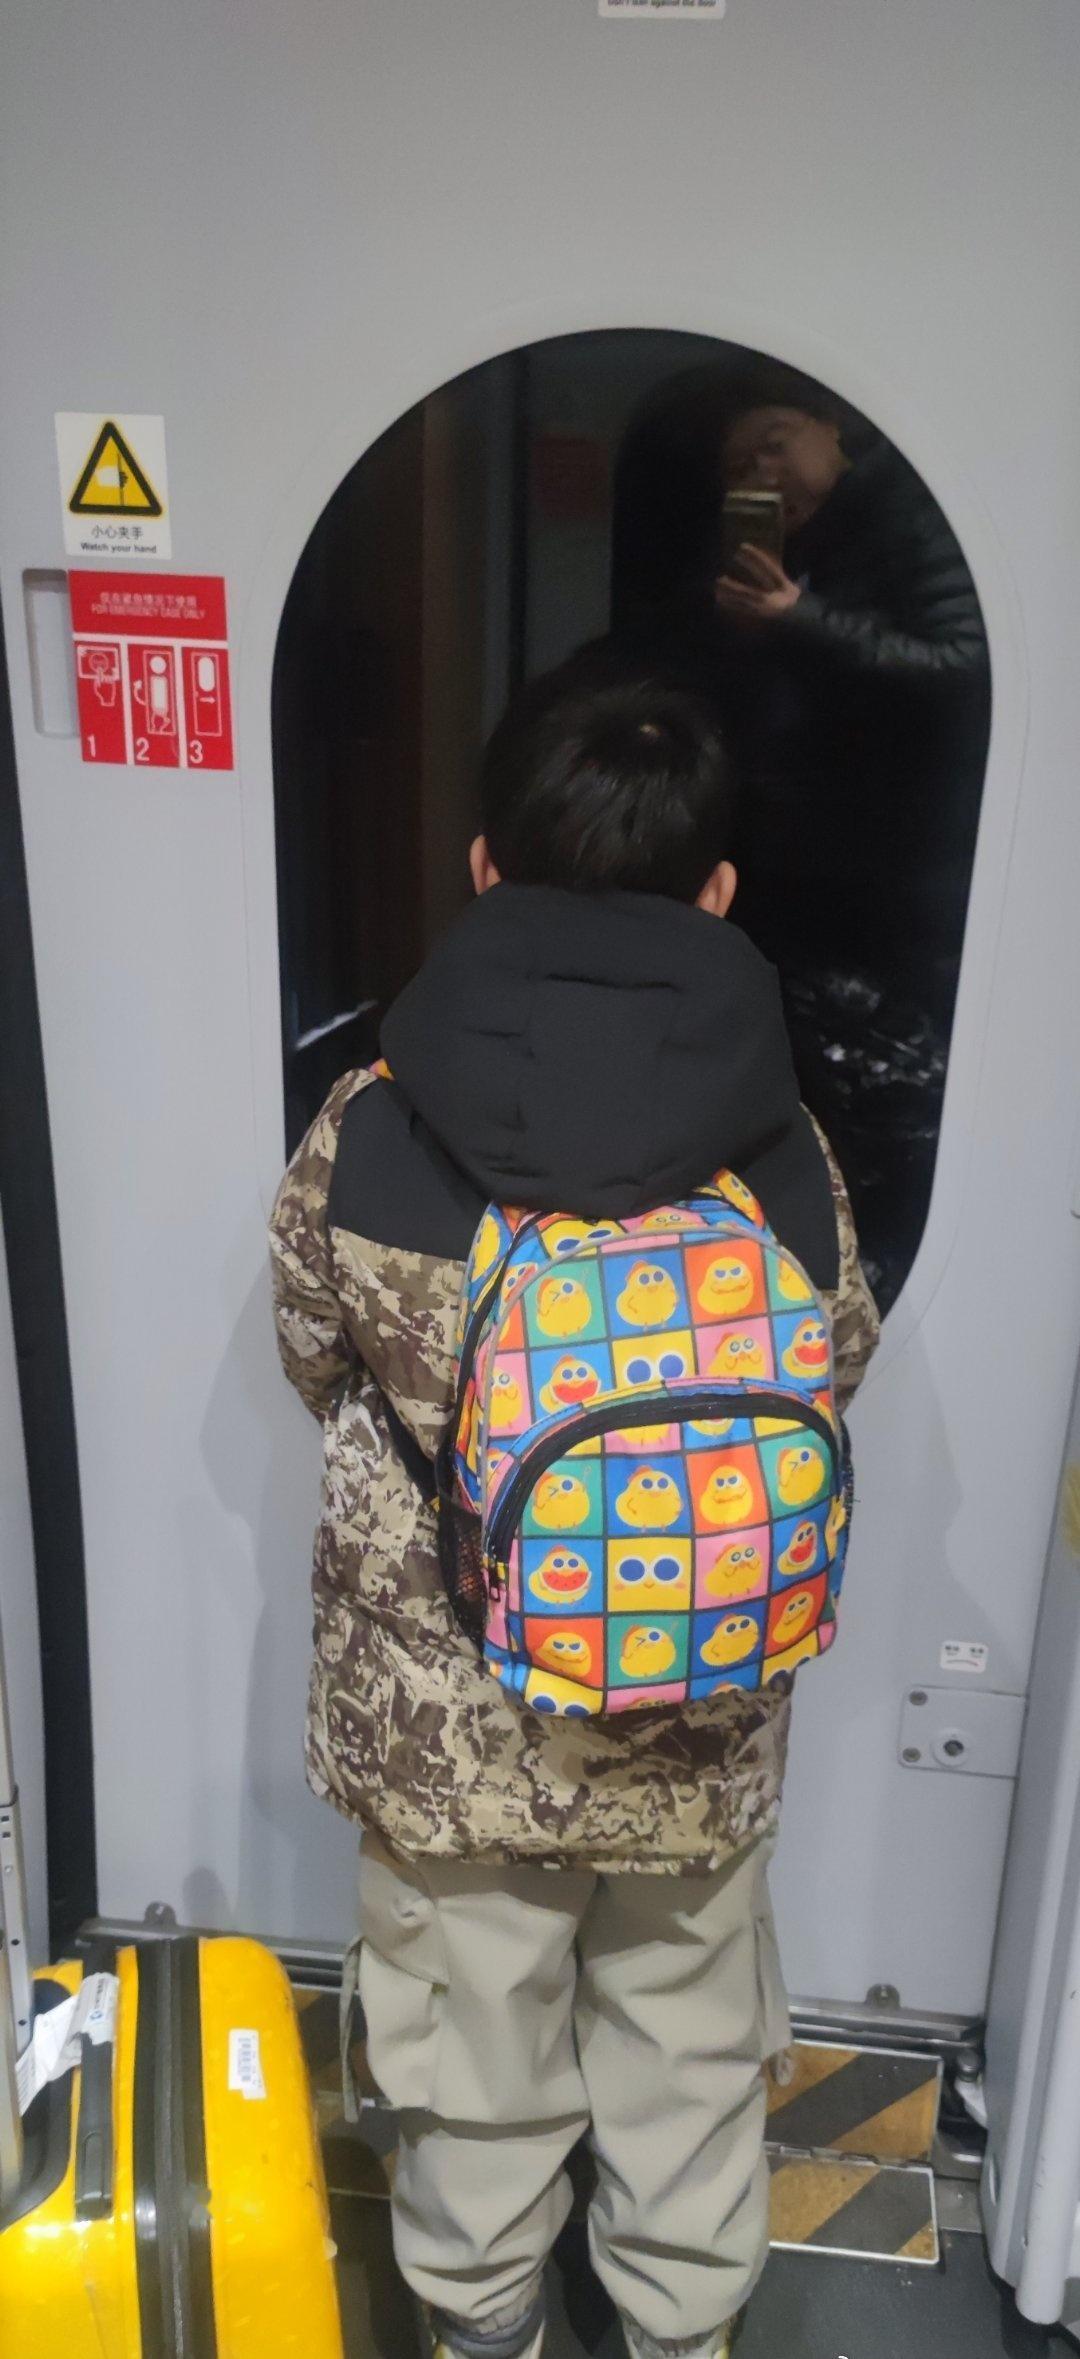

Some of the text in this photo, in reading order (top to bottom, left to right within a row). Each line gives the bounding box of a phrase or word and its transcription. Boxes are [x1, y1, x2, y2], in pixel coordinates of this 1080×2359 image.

[91, 525, 144, 540] 小心夹手
[81, 542, 157, 554] Watch your hand
[87, 734, 203, 764] 1 2 3
